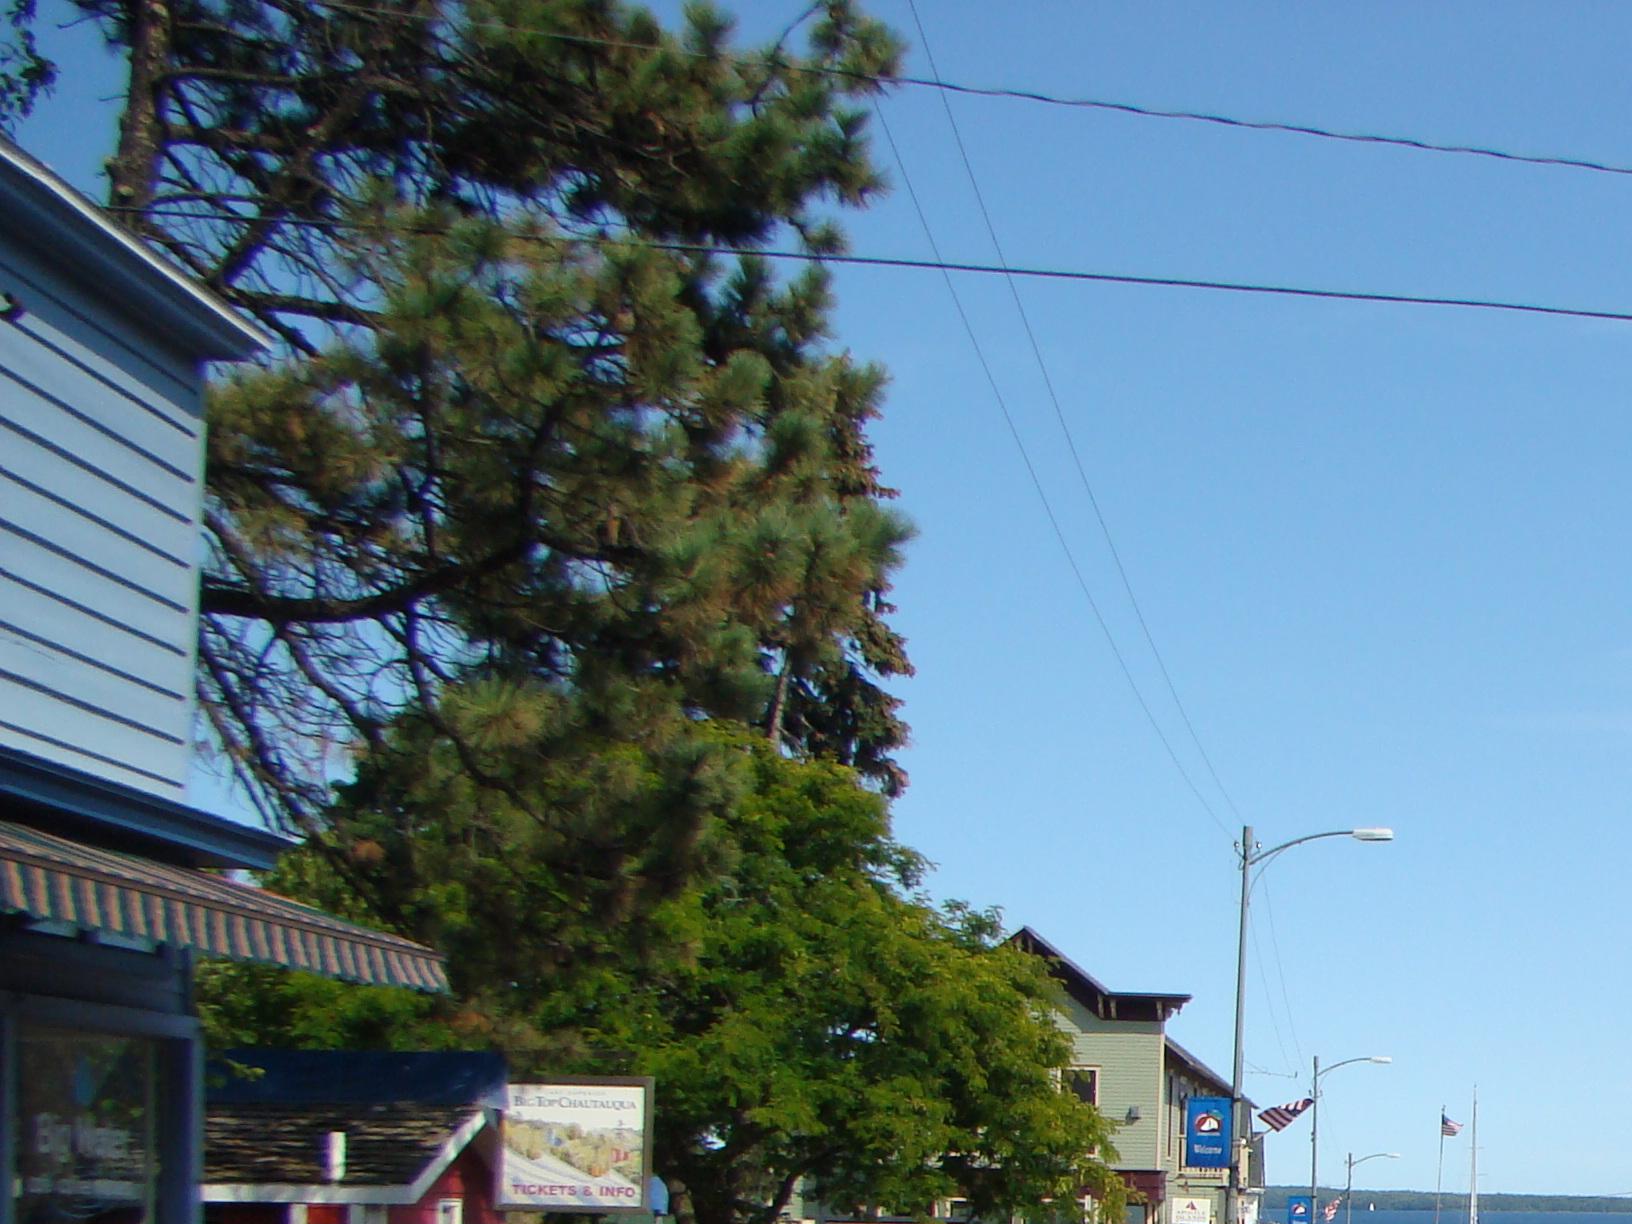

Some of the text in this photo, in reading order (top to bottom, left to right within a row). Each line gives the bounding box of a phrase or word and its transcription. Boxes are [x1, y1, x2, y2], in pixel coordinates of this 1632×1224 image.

[514, 1096, 637, 1110] BIG TOP CHAUTAUQUA
[1193, 1144, 1222, 1154] Welcome
[511, 1184, 636, 1198] TICKETS & INFO
